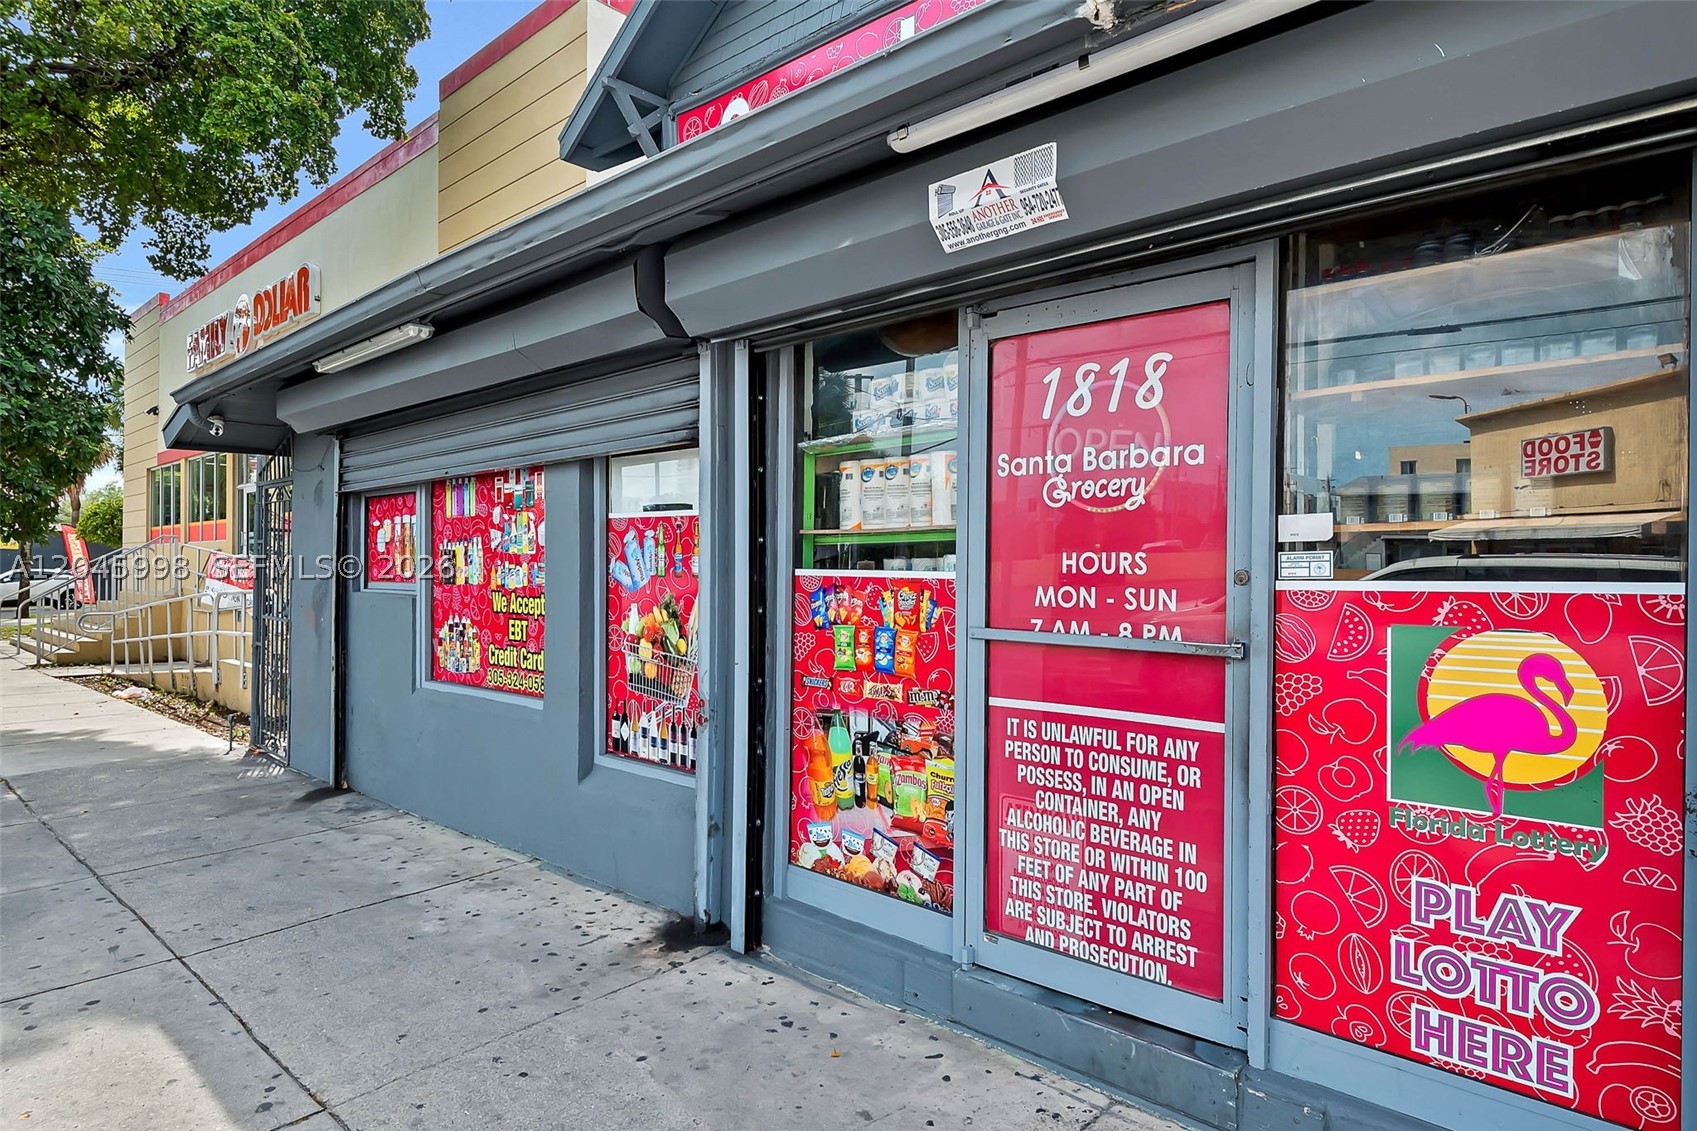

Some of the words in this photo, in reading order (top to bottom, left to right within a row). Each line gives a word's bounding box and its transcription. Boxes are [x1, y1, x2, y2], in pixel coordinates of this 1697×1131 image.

[972, 199, 1018, 222] ANOTHER
[976, 218, 995, 231] GARAGE
[1000, 213, 1012, 225] GATE
[948, 221, 1026, 249] www.anothergng.com
[252, 264, 311, 338] DOLLAR
[1041, 351, 1173, 420] 1818
[996, 450, 1073, 478] Santa
[1083, 442, 1206, 472] Barbara
[1042, 474, 1146, 511] Grocery
[1061, 551, 1148, 576] HOURS
[492, 591, 507, 613] We
[509, 592, 545, 619] Accept
[1034, 586, 1096, 609] MON
[1124, 587, 1177, 612] SUN
[509, 619, 528, 641] EBT
[1030, 619, 1043, 632] 7
[1053, 620, 1090, 635] AM
[1118, 622, 1132, 638] 8
[1143, 624, 1182, 641] PM
[488, 643, 518, 668] Credit
[520, 647, 544, 672] Card
[806, 676, 828, 688] SNICKERS
[1007, 717, 1019, 737] IT
[1023, 721, 1037, 739] IS
[1042, 722, 1122, 751] UNLAWFUL
[1127, 732, 1158, 755] FOR
[1163, 737, 1200, 762] ANY
[896, 773, 927, 790] Zambos
[1005, 739, 1061, 766] PERSON
[1065, 747, 1084, 769] TO
[1088, 751, 1173, 787] CONSUME,
[1177, 764, 1201, 789] OR
[1017, 764, 1087, 797] POSSESS,
[1091, 775, 1107, 797] IN
[1112, 779, 1135, 800] AN
[1140, 784, 1185, 811] OPEN
[1035, 790, 1123, 828] CONTAINER,
[1128, 806, 1162, 832] ANY
[1006, 808, 1086, 840] ALCOHOLIC
[1090, 823, 1174, 860] BEVERAGE
[1179, 841, 1197, 865] IN
[1388, 805, 1487, 843] Florida
[1494, 822, 1607, 865] Lottery
[999, 828, 1029, 852] THIS
[1034, 835, 1080, 863] STORE
[1085, 846, 1106, 869] OR
[1110, 852, 1169, 884] WITHIN
[1175, 867, 1208, 893] 100
[1017, 855, 1051, 879] FEET
[1055, 863, 1074, 885] OF
[1078, 868, 1109, 894] ANY
[1114, 877, 1156, 904] PART
[1161, 889, 1183, 912] OF
[1010, 875, 1042, 901] THIS
[1045, 884, 1098, 915] STORE.
[1101, 898, 1191, 941] VIOLATORS
[1410, 875, 1583, 957] PLAY
[1005, 898, 1033, 922] ARE
[1036, 905, 1102, 941] SUBJECT
[1107, 923, 1127, 948] TO
[1131, 931, 1198, 968] ARREST
[1025, 926, 1055, 949] AND
[1059, 938, 1173, 986] PROSECUTION.
[1390, 933, 1600, 1030] LOTTO
[1410, 1003, 1574, 1100] HERE
